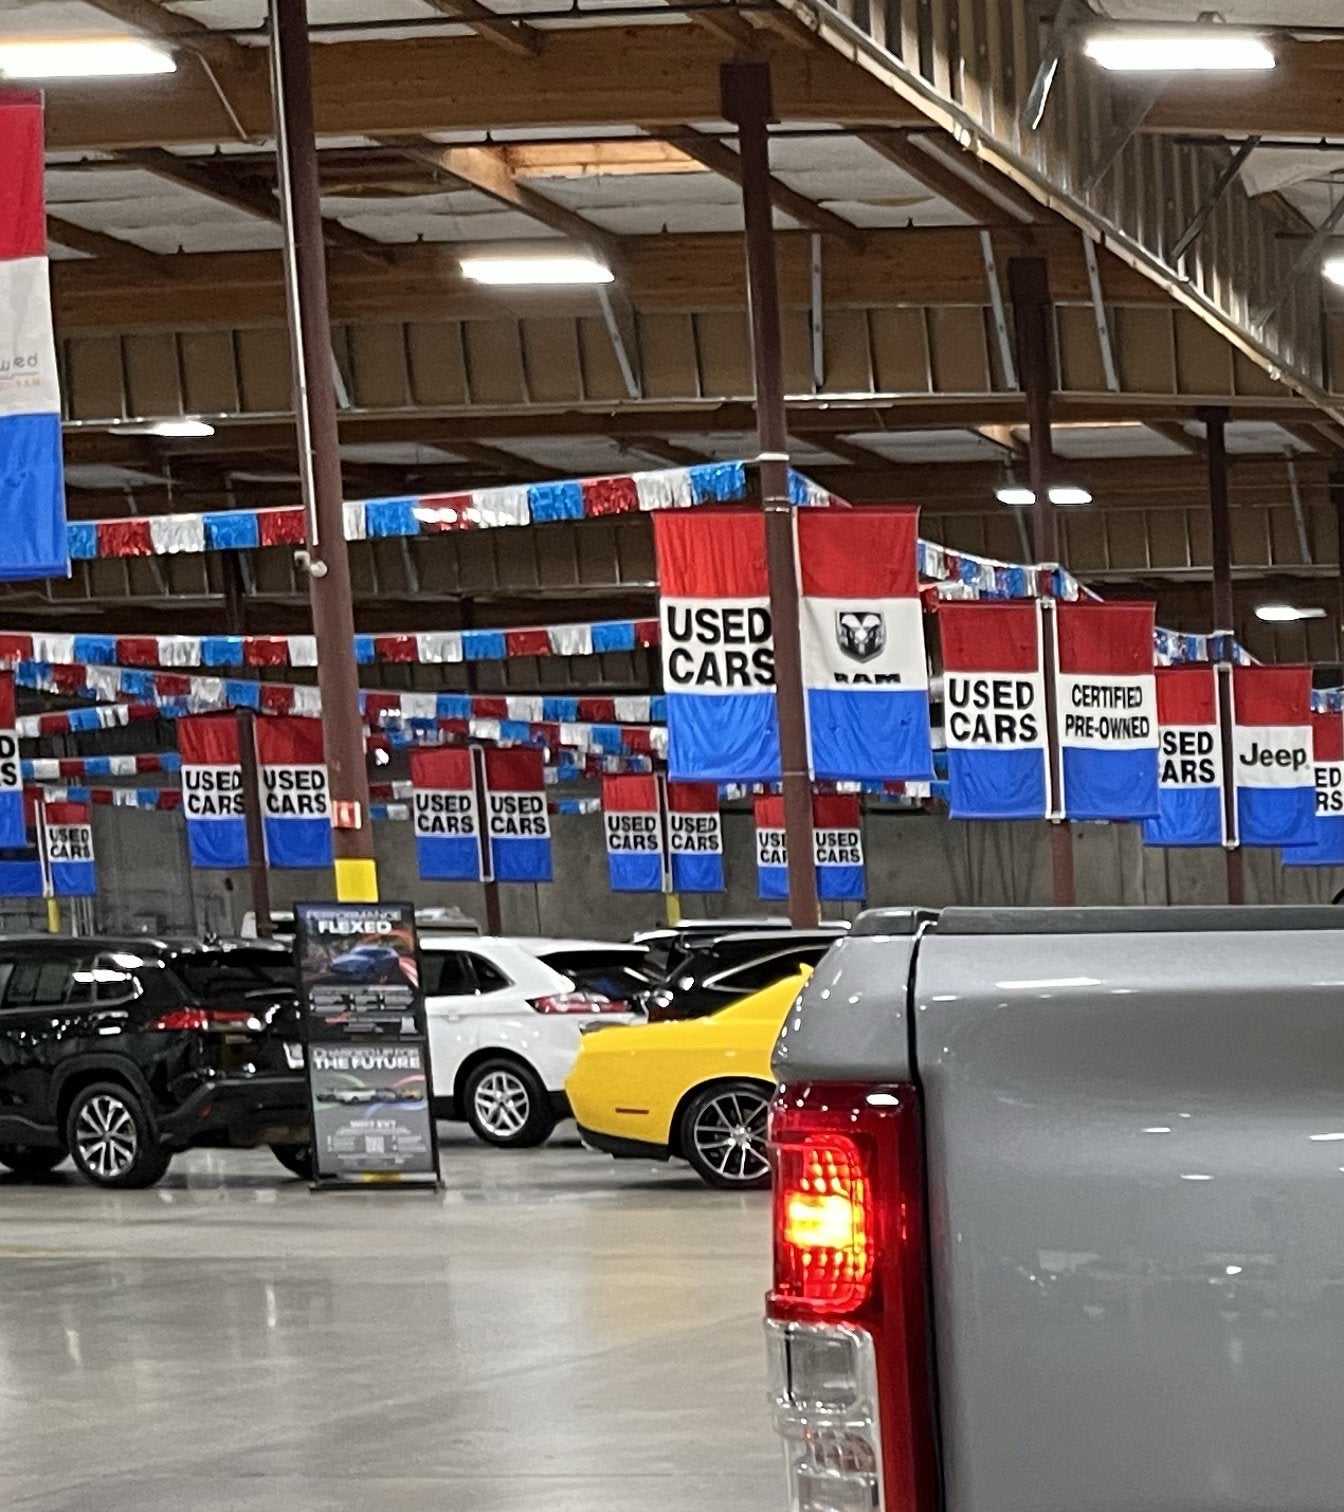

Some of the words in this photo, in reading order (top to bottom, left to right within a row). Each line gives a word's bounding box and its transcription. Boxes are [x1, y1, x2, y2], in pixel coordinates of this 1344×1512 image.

[667, 606, 772, 645] USED
[668, 647, 775, 687] CARS
[833, 672, 902, 685] RAM
[949, 679, 1035, 711] USED
[1071, 684, 1143, 709] CERTIFIED
[949, 713, 1038, 744] CARS
[1065, 714, 1150, 740] PRE-OWNED
[1160, 731, 1214, 756] SED
[1240, 743, 1307, 771] Jeep
[263, 770, 325, 790] USED
[1161, 758, 1216, 783] ARS
[185, 770, 243, 791] USED
[188, 794, 245, 815] CARS
[266, 793, 327, 814] CARS
[416, 794, 472, 813] USED
[490, 796, 544, 815] USED
[417, 814, 474, 833] CARS
[491, 816, 546, 835] CARS
[608, 815, 657, 832] USED
[671, 816, 718, 833] USED
[50, 828, 89, 843] USED
[609, 834, 658, 851] CARS
[671, 834, 719, 851] CARS
[815, 832, 858, 847] USED
[50, 844, 90, 859] CARS
[816, 848, 860, 863] CARS
[318, 920, 392, 934] FLEXED
[315, 1056, 349, 1070] THE
[352, 1056, 421, 1070] FUTURE
